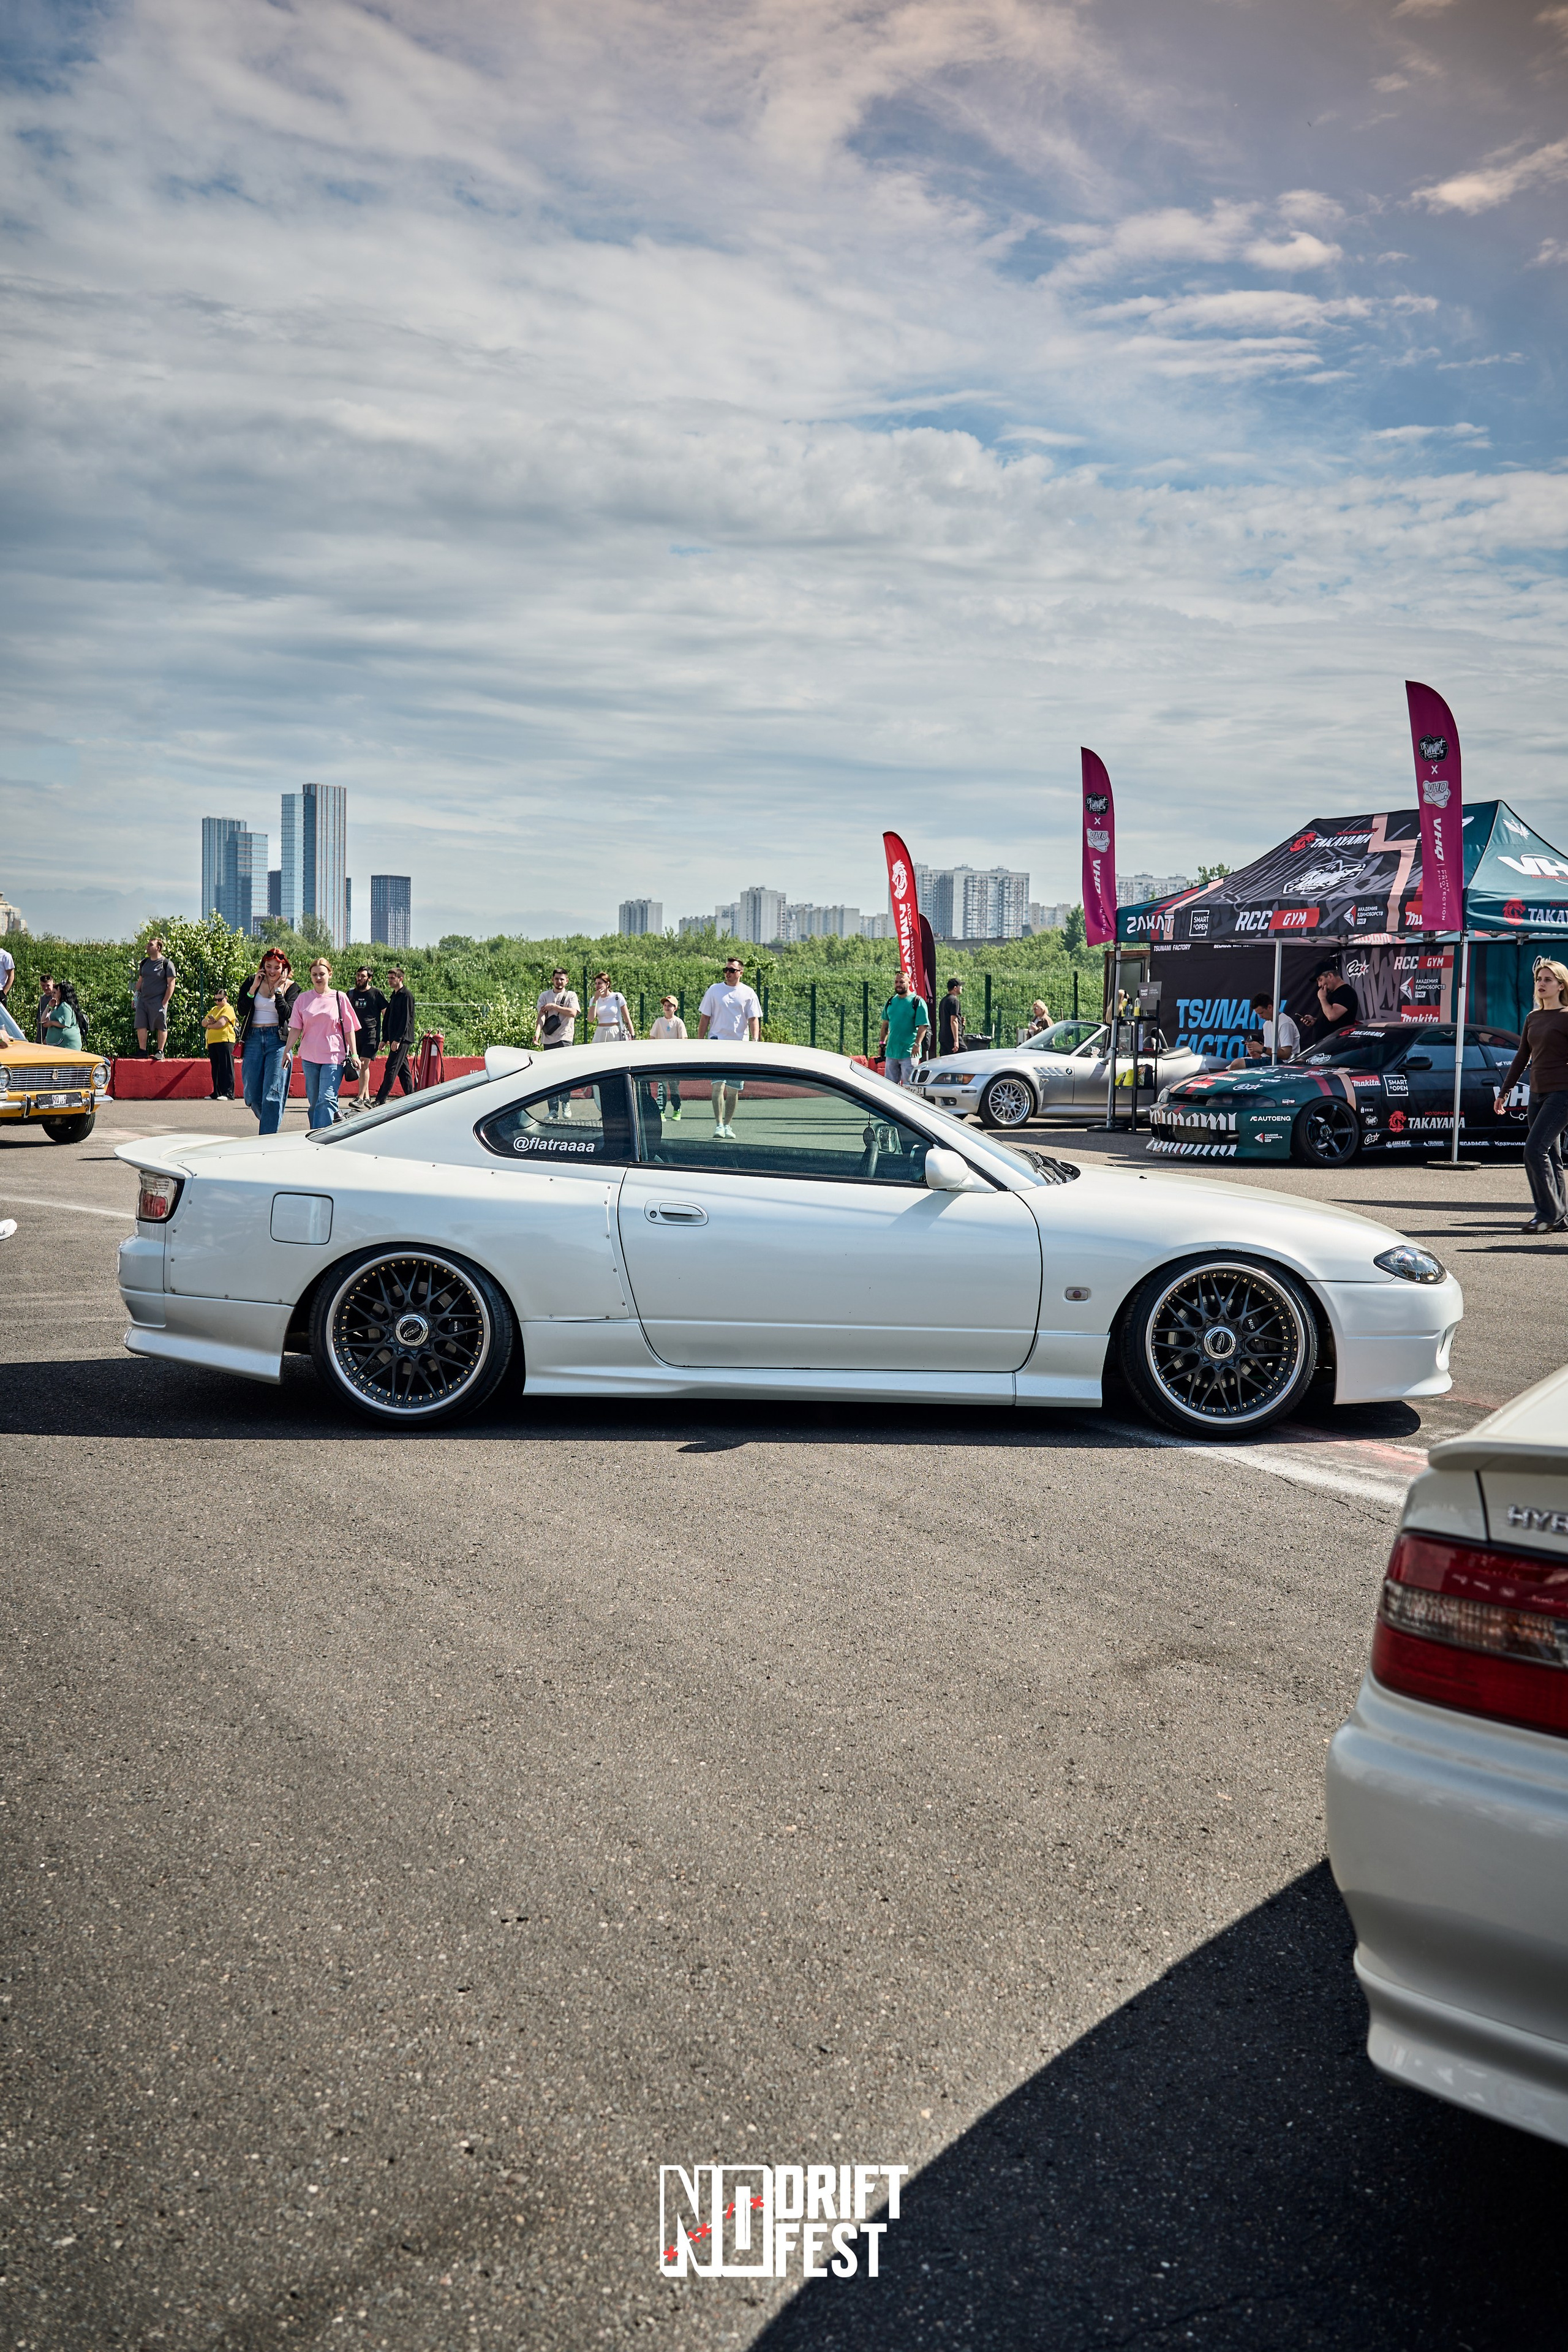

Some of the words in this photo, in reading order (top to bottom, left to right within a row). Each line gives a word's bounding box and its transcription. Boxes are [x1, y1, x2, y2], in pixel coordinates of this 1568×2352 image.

[1428, 782, 1447, 793] VHQ
[1310, 834, 1374, 848] TAKAYAMA
[1433, 818, 1444, 861] VHQ
[1235, 910, 1273, 931] RCC
[1282, 911, 1307, 926] GYM
[1393, 956, 1419, 970] RCC
[1427, 957, 1444, 967] GYM
[1401, 1013, 1439, 1022] makita
[1352, 1079, 1381, 1087] makita
[1493, 1086, 1530, 1107] VH
[513, 1136, 595, 1152] @flatraaaa
